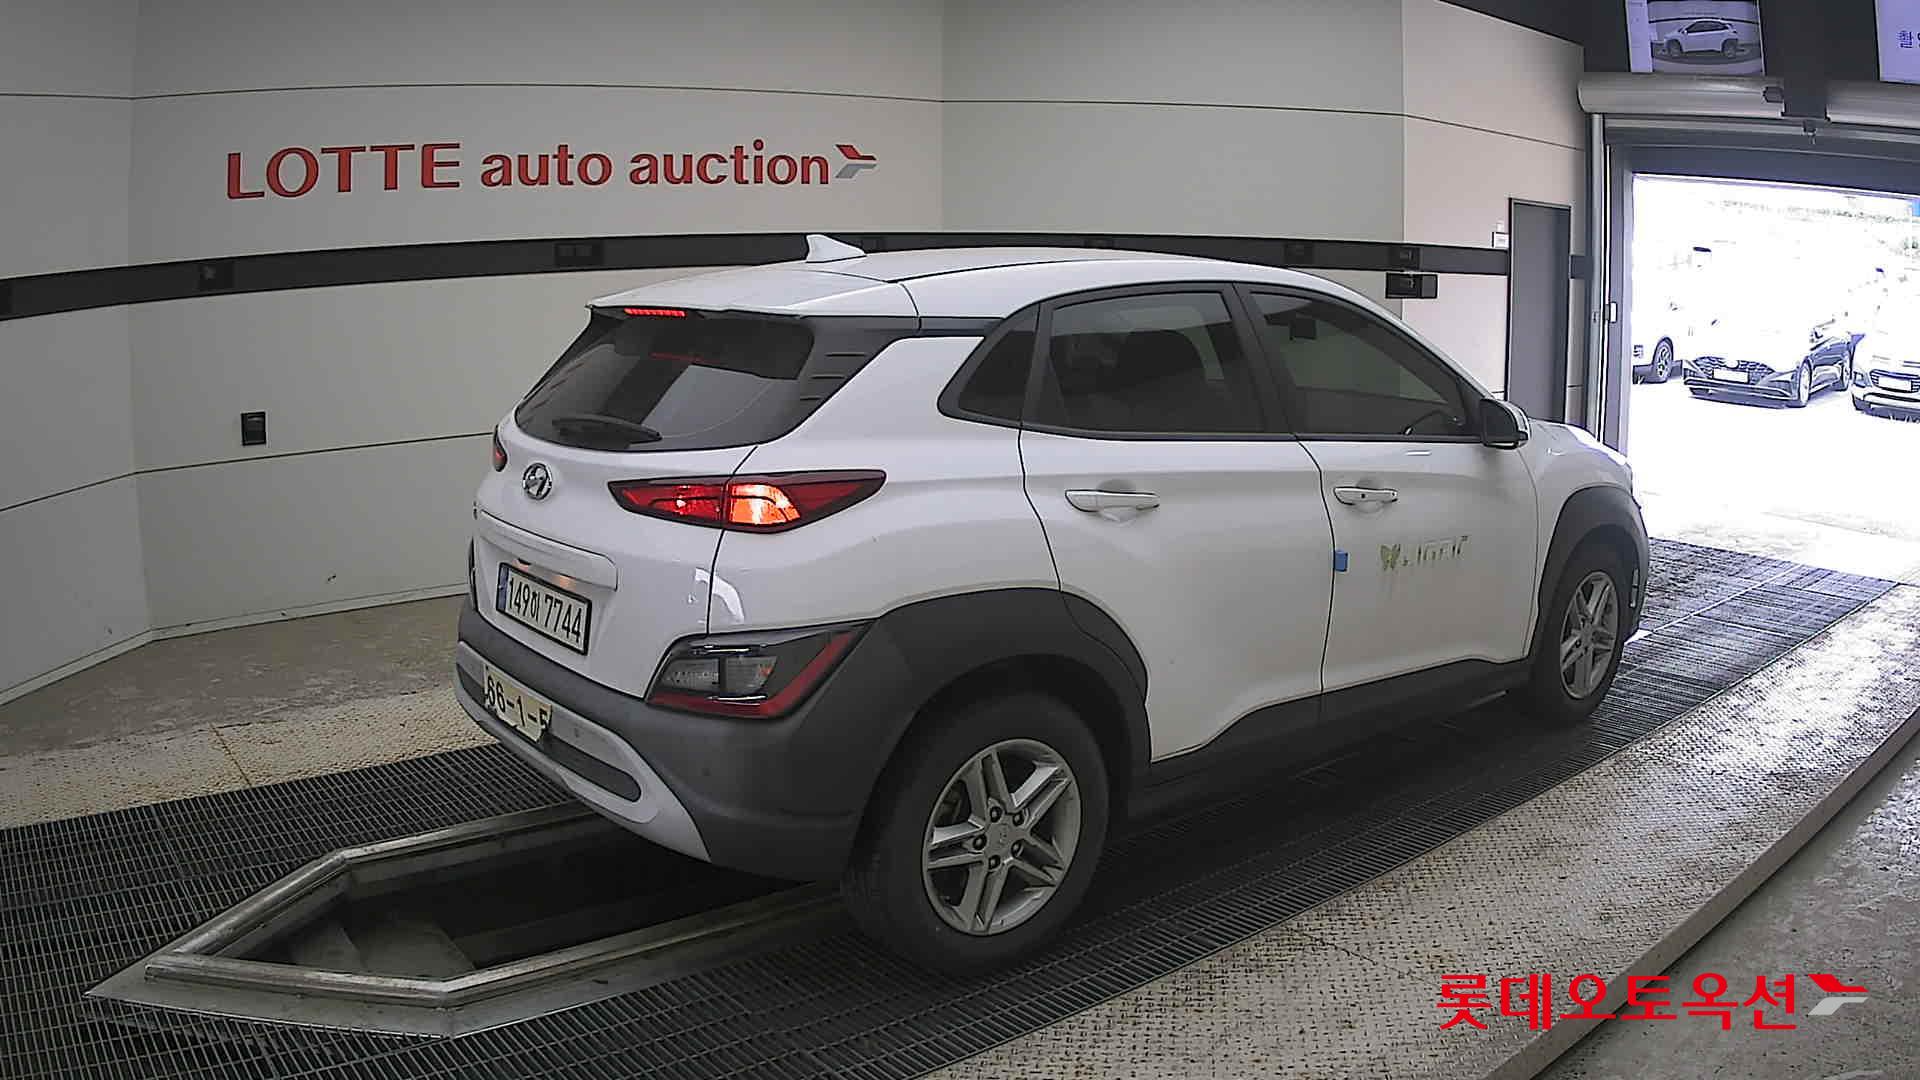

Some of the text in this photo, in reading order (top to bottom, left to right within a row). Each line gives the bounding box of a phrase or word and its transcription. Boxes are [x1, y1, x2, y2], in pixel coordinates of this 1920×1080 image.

[228, 138, 829, 199] LOTTE auto auction
[544, 593, 582, 643] 7744
